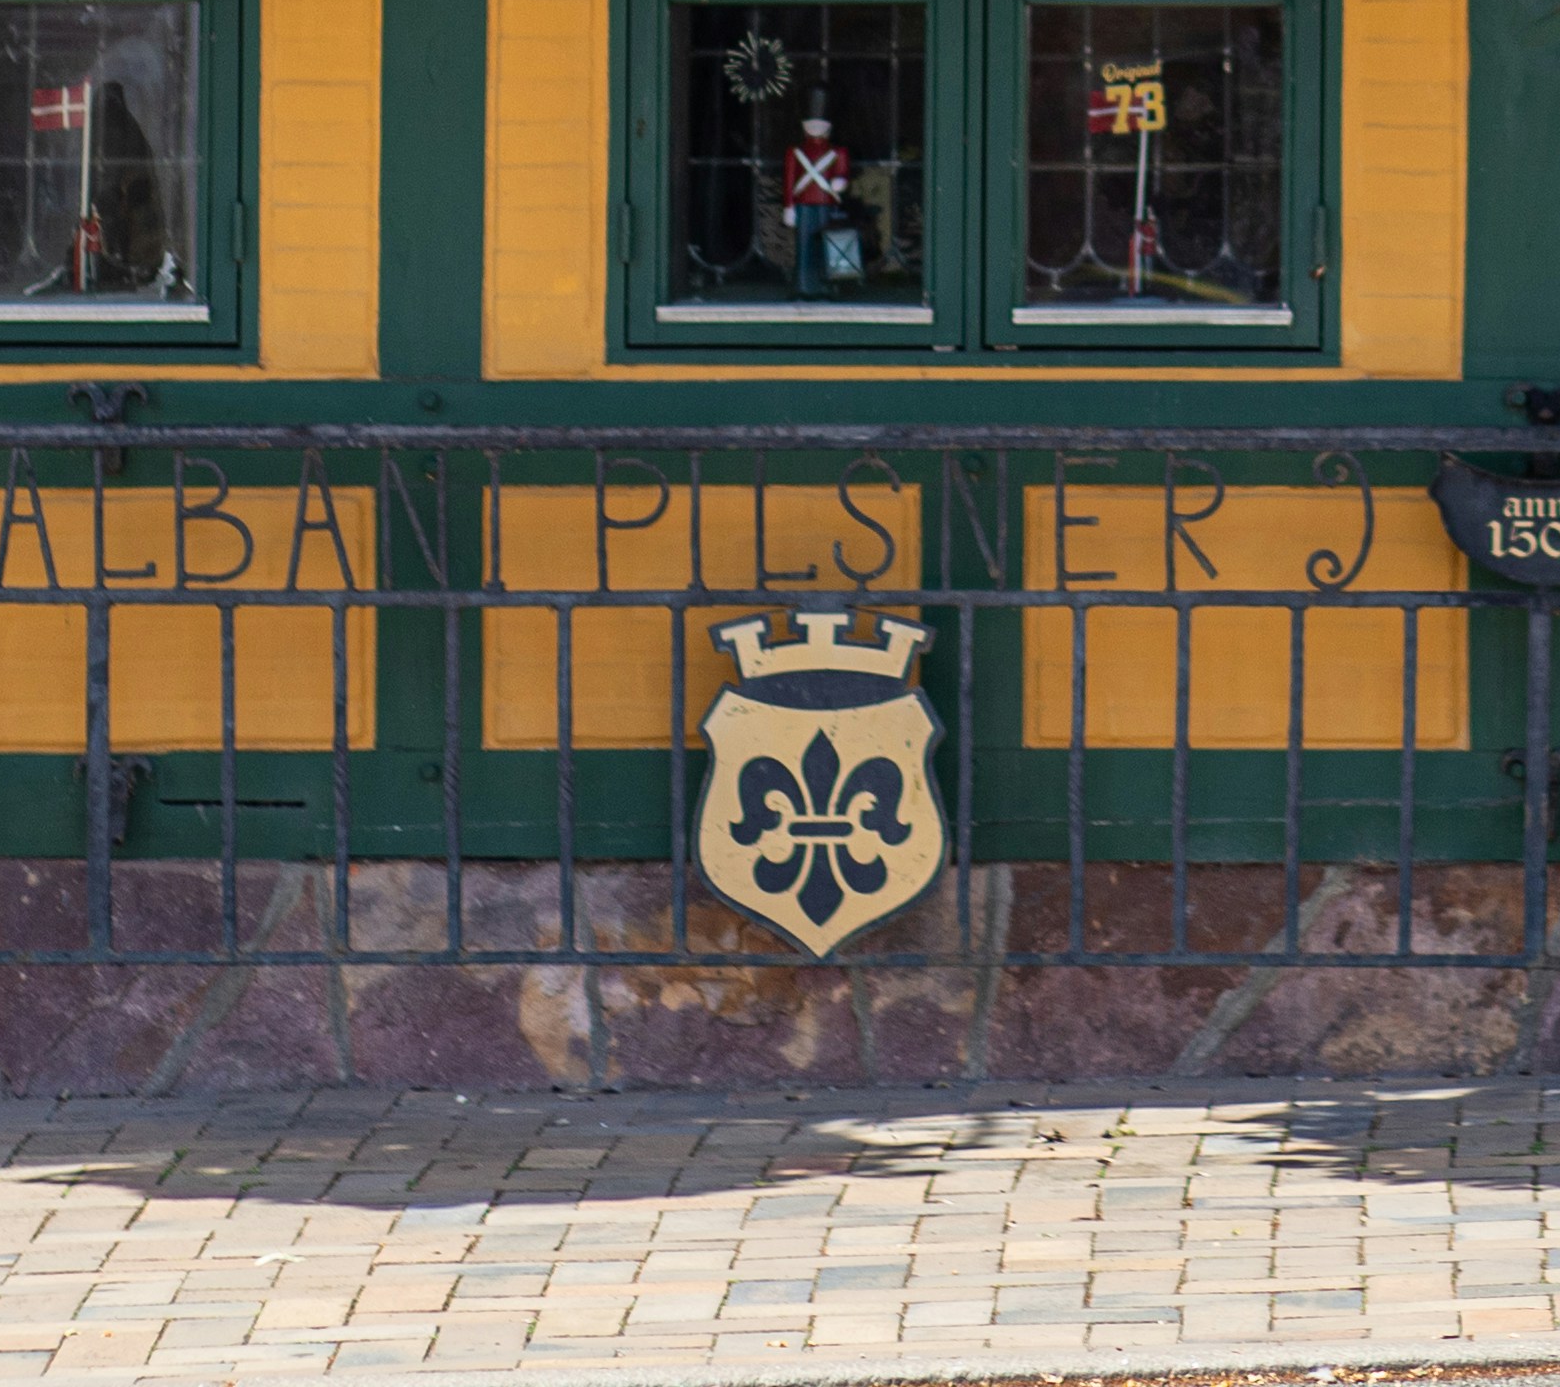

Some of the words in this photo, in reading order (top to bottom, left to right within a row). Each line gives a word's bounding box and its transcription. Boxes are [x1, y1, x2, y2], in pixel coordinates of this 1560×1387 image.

[1102, 59, 1163, 83] Original
[1105, 83, 1166, 135] 73
[596, 447, 1226, 592] PILSNER
